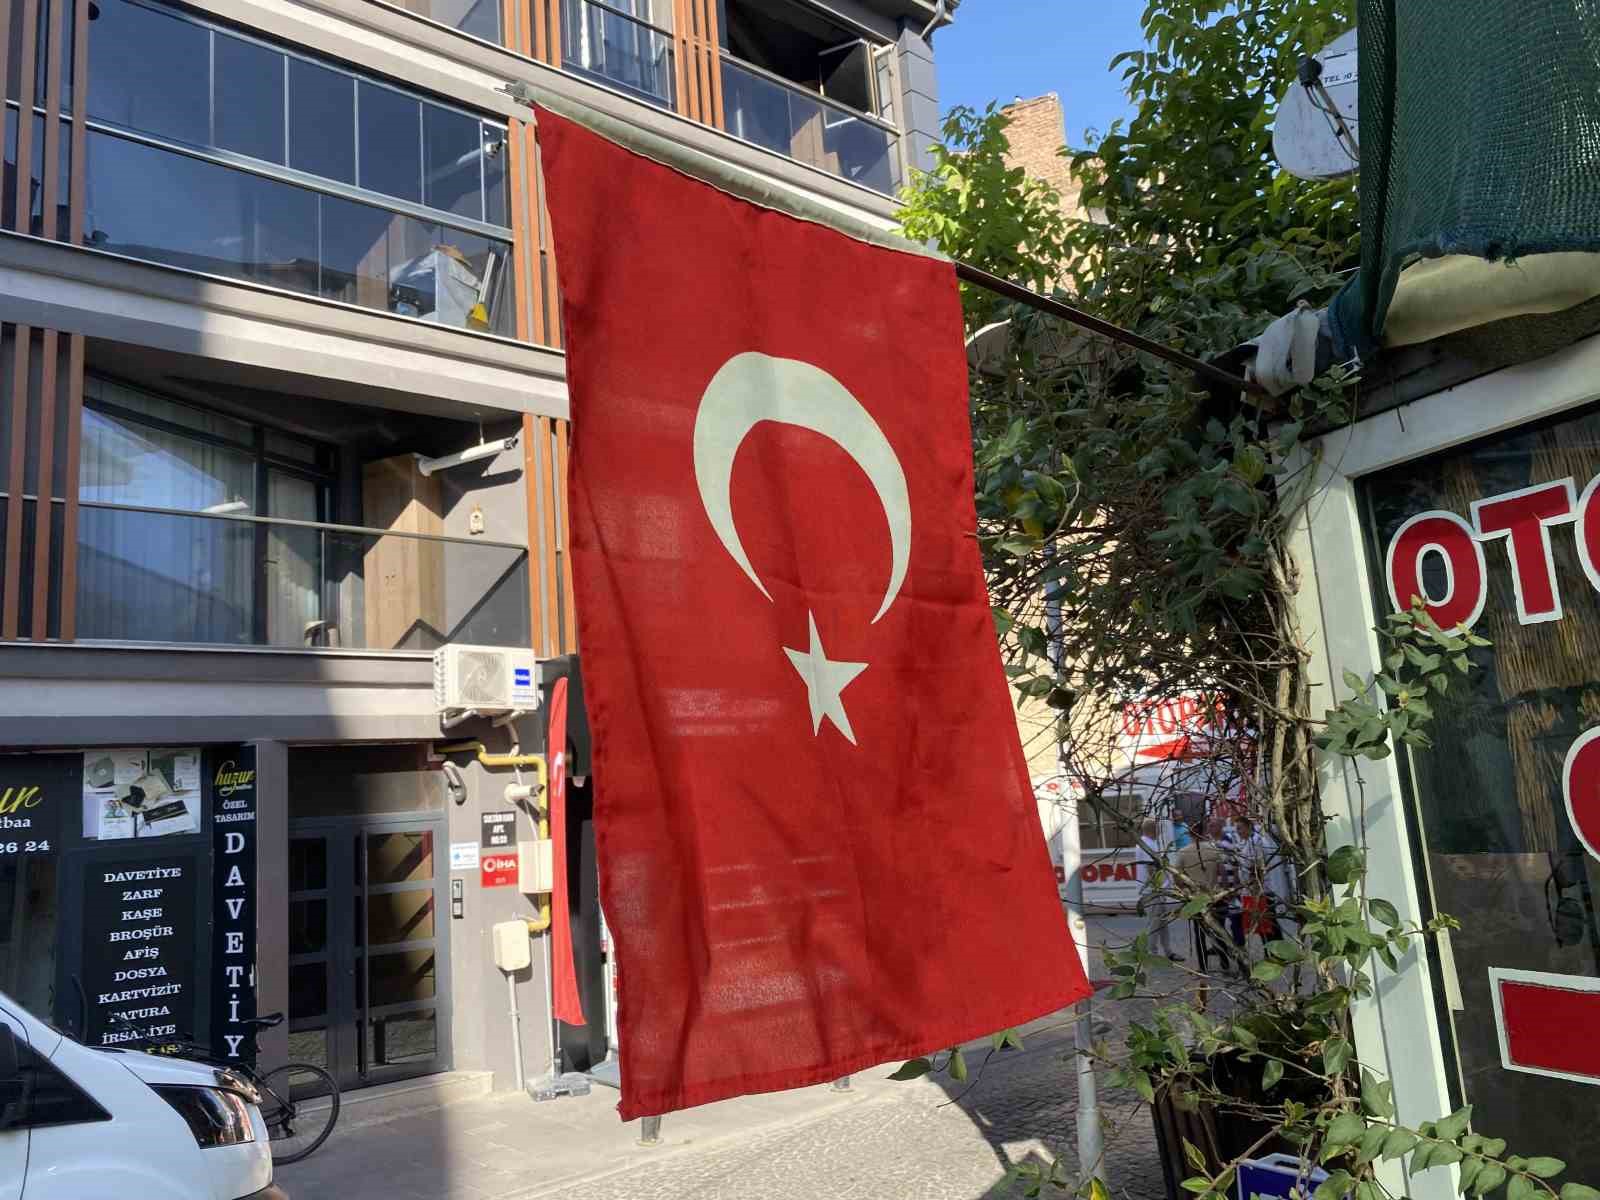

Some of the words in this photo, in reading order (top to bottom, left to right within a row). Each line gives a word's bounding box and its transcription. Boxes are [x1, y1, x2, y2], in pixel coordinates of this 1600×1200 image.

[1386, 474, 1600, 639] OT
[214, 811, 256, 823] TASARIM
[24, 840, 50, 852] 24
[103, 867, 182, 883] DAVETİYE
[122, 888, 163, 901] ZARF
[121, 907, 163, 921] KAŞE
[109, 925, 174, 942] BROŞÜR
[123, 945, 160, 961] AFİŞ
[113, 966, 167, 982] DOSYA
[98, 982, 182, 1004] KARTVİZİT
